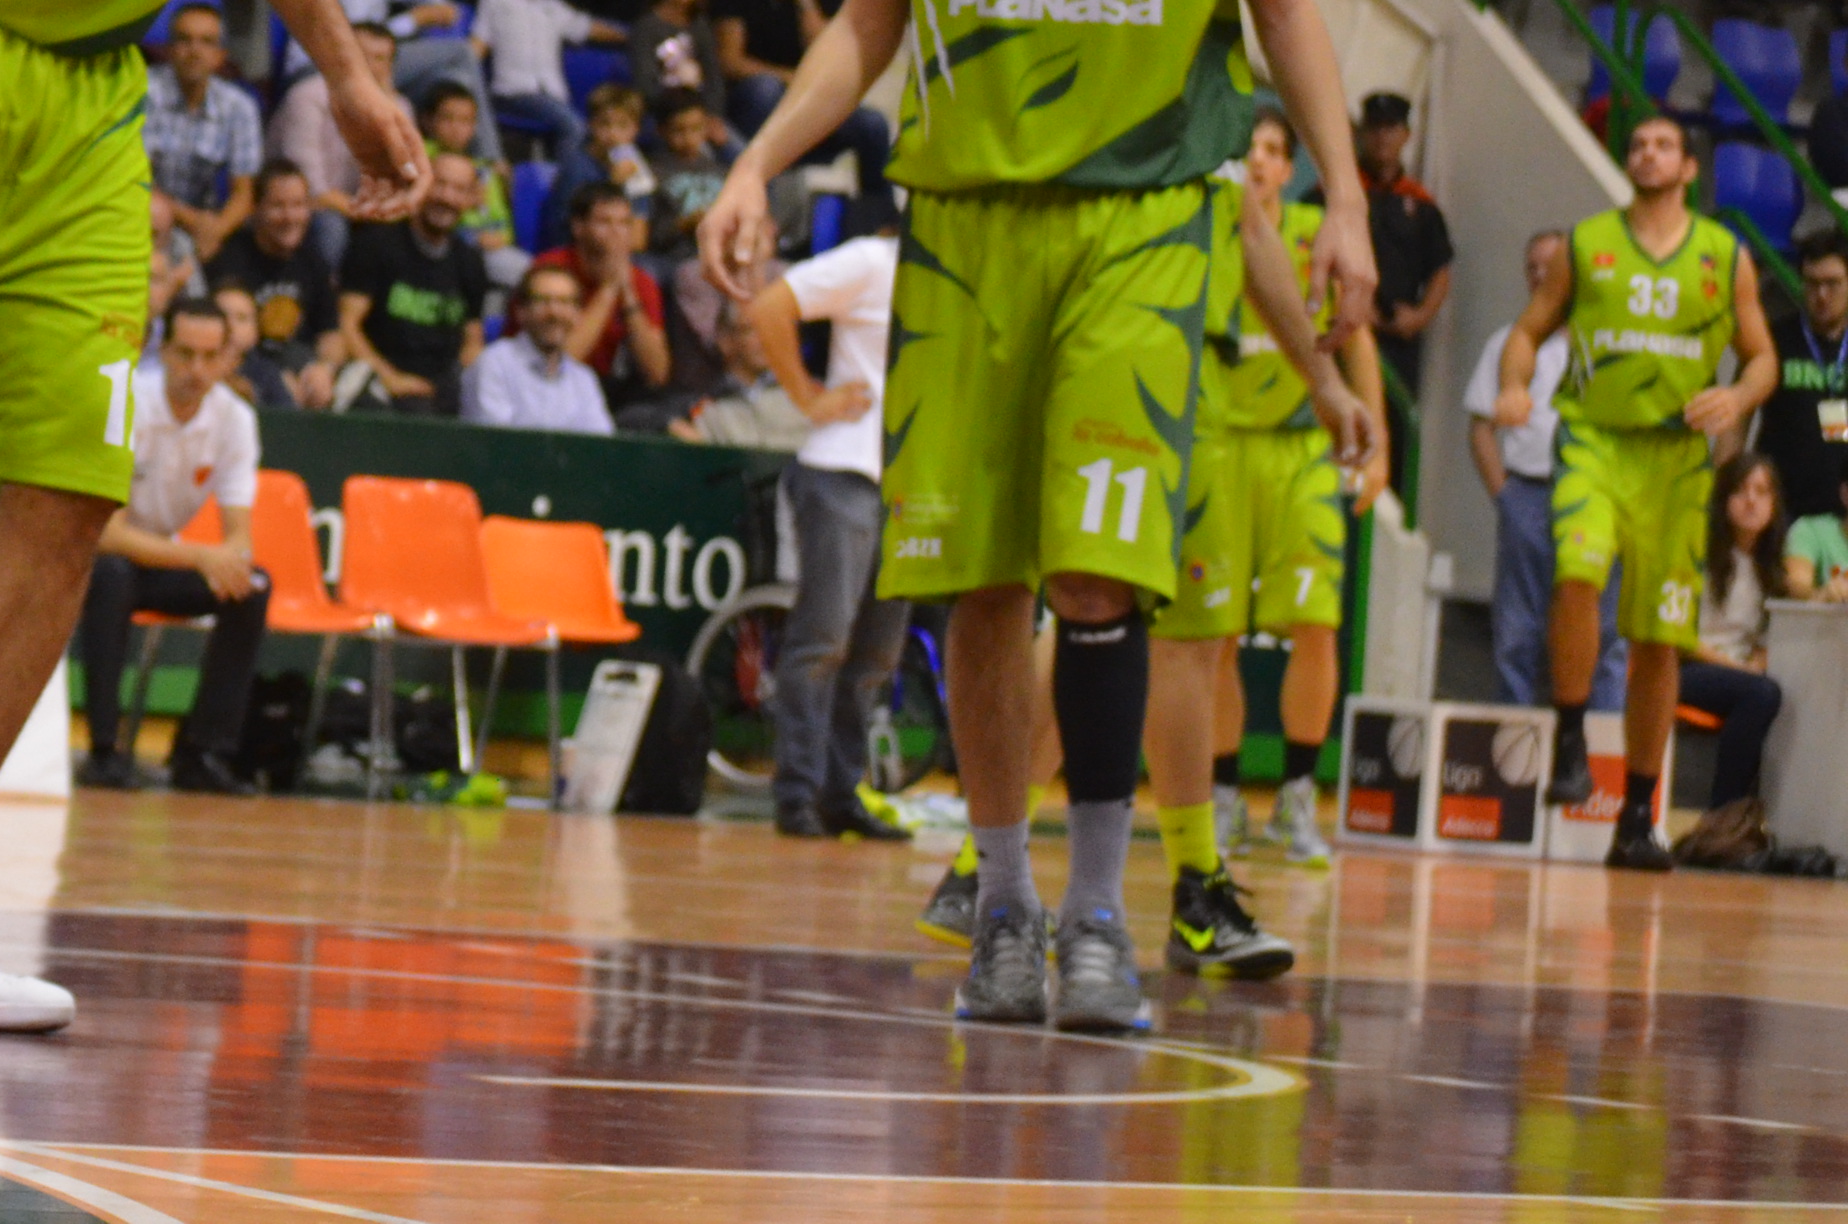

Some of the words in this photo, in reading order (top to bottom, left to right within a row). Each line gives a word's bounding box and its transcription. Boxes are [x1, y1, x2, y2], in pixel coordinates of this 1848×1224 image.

[1628, 274, 1680, 319] 33
[99, 359, 135, 450] 1
[1077, 458, 1148, 543] 11
[1295, 568, 1315, 606] 7
